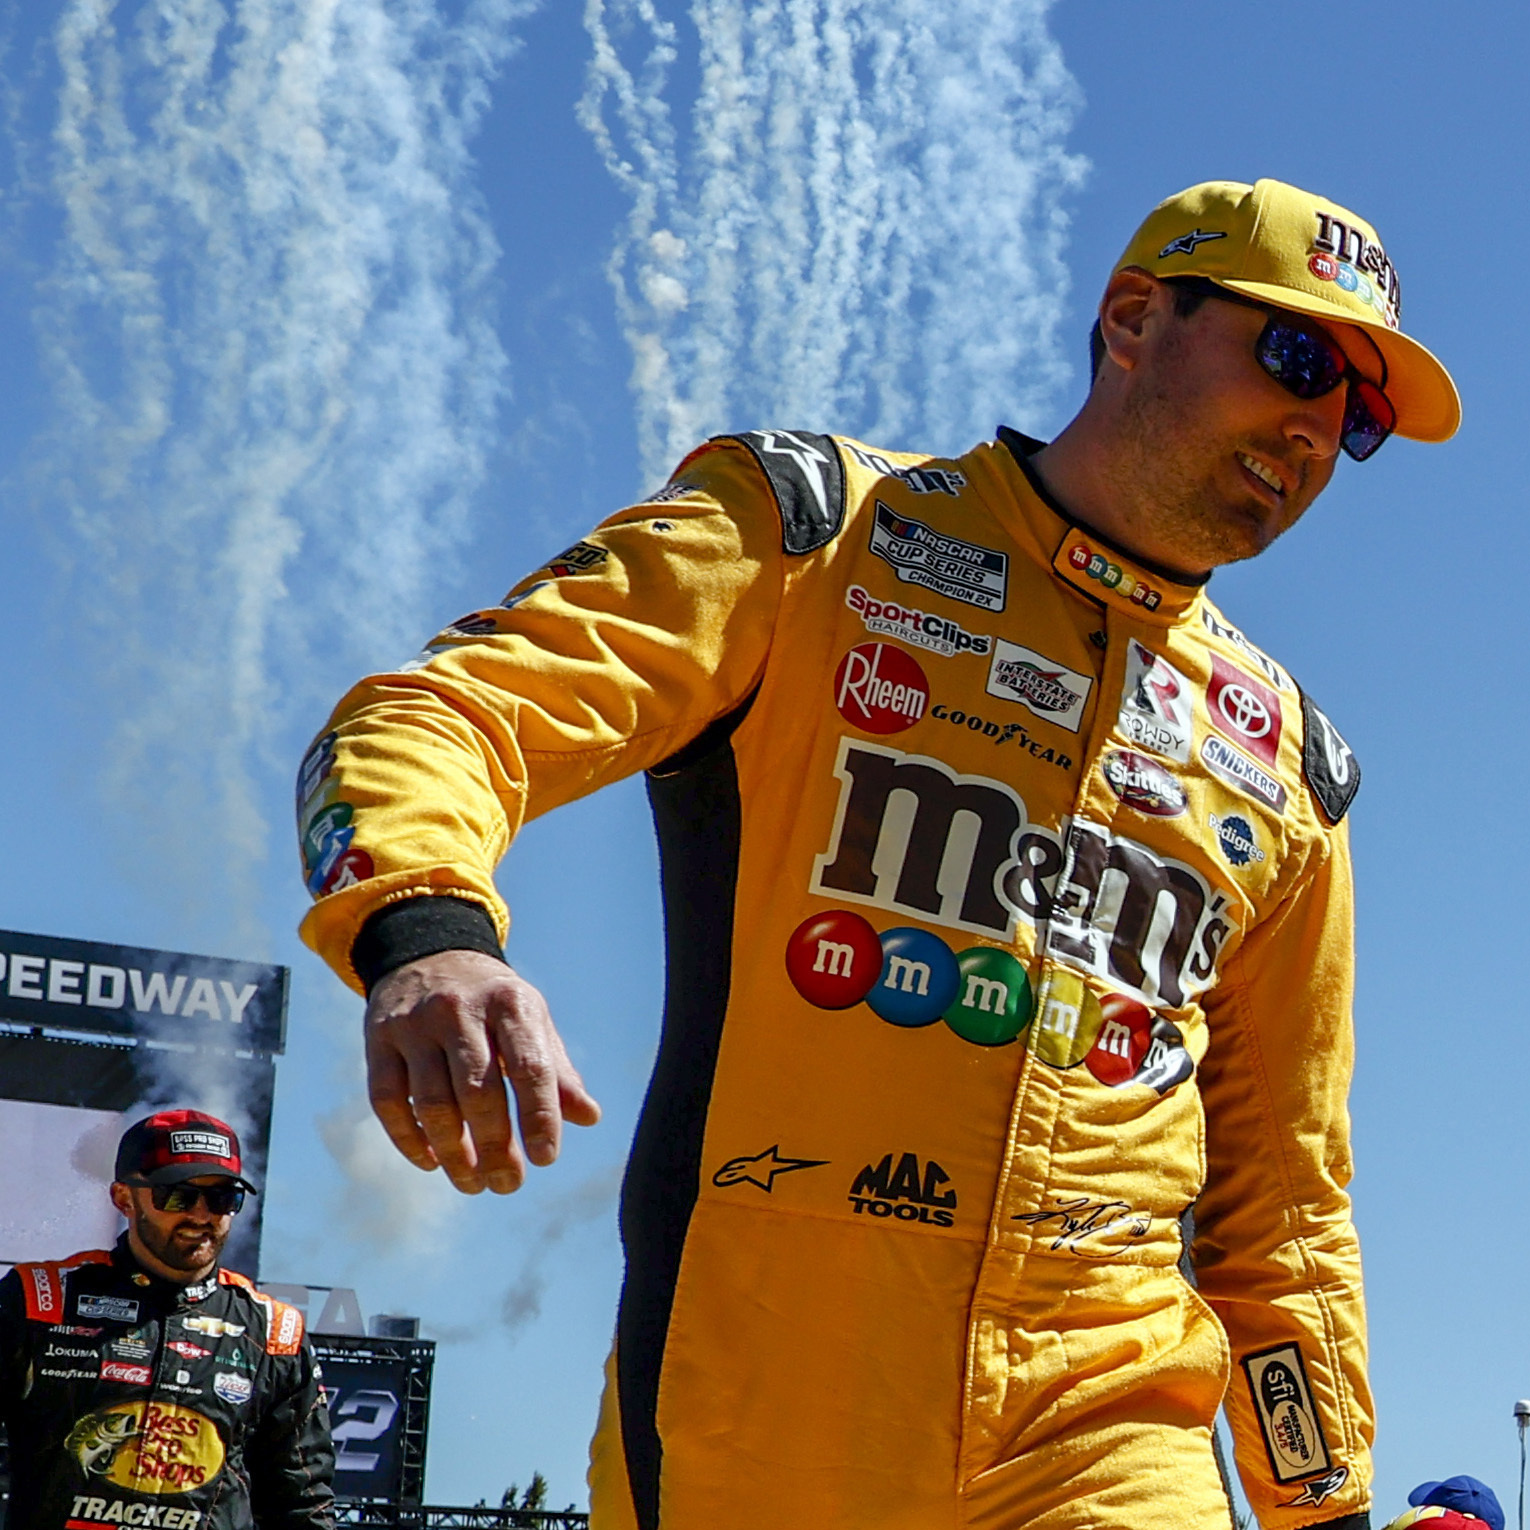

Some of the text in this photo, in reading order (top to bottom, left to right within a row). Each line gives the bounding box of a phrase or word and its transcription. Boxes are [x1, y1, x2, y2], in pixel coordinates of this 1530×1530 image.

[887, 540, 987, 584] CUP SERIES
[913, 524, 986, 566] NASCAR
[908, 570, 994, 608] CHAMPION 2X
[848, 587, 990, 654] SportClips
[869, 619, 951, 653] HAIRCUTS
[837, 642, 927, 720] Rheem
[998, 660, 1079, 704] INTERSTATE
[998, 674, 1070, 713] BATTERIES
[930, 704, 1073, 771] GOODYEAR
[1121, 710, 1185, 750] ROWDY
[1109, 762, 1184, 806] Skittles
[1203, 737, 1279, 800] SNICKERS
[1207, 813, 1265, 863] Pedigree
[818, 746, 1229, 1009] m&m's
[0, 953, 258, 1024] EEDWAY
[812, 938, 855, 978] m
[883, 952, 931, 997] m
[960, 971, 1009, 1016] m
[1097, 1018, 1131, 1059] m
[849, 1152, 957, 1210] MAC
[847, 1195, 955, 1228] TOOLS
[1266, 1369, 1296, 1401] sfi
[139, 1406, 201, 1437] Bass
